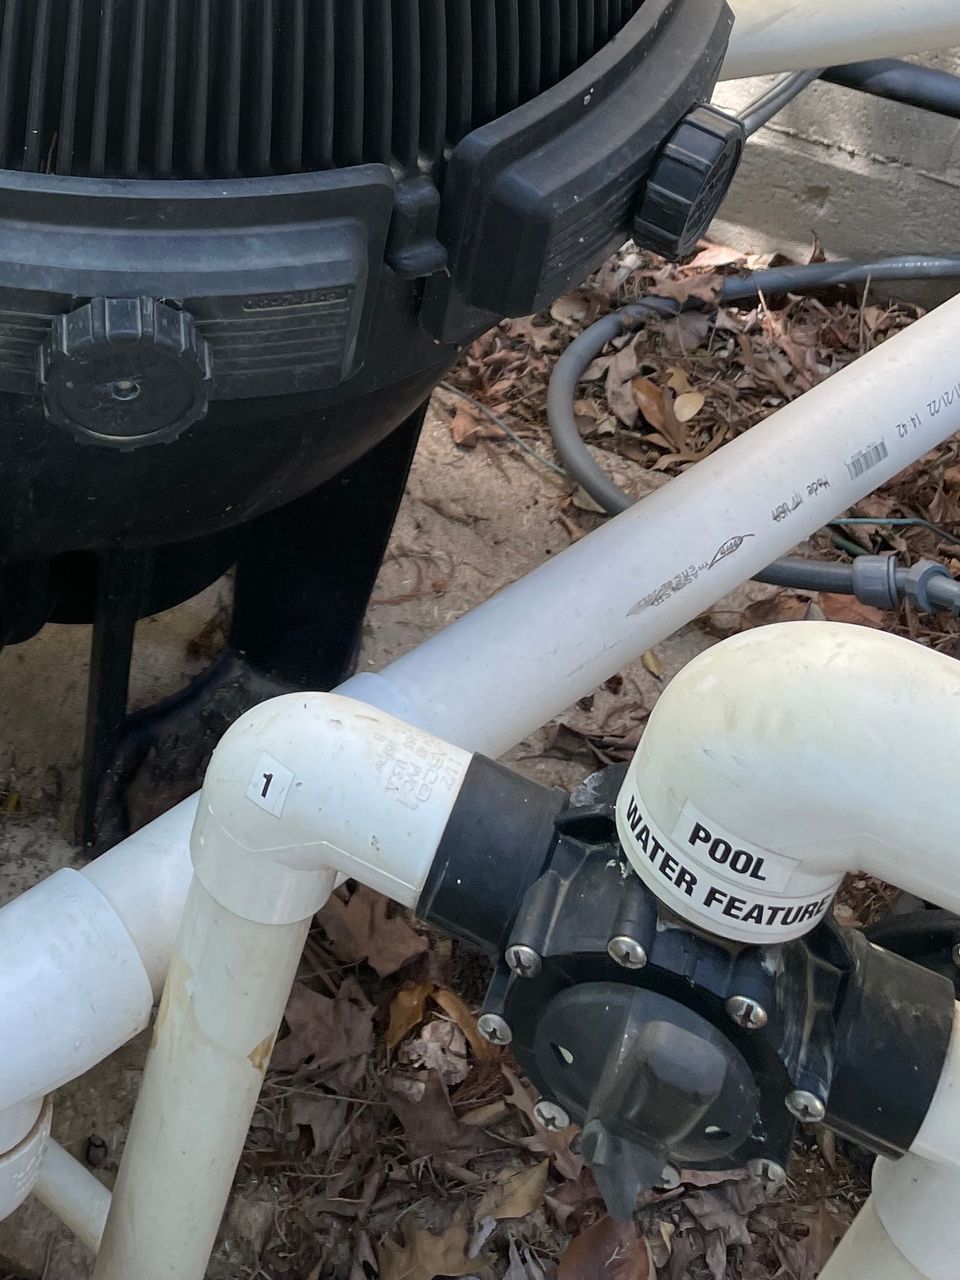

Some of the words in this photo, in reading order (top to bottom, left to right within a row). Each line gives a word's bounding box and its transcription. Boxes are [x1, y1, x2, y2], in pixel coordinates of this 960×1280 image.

[896, 413, 922, 438] 14:42
[260, 772, 274, 799] 1
[625, 794, 699, 898] WATER
[702, 885, 832, 927] FEATURE
[688, 821, 767, 882] POOL
